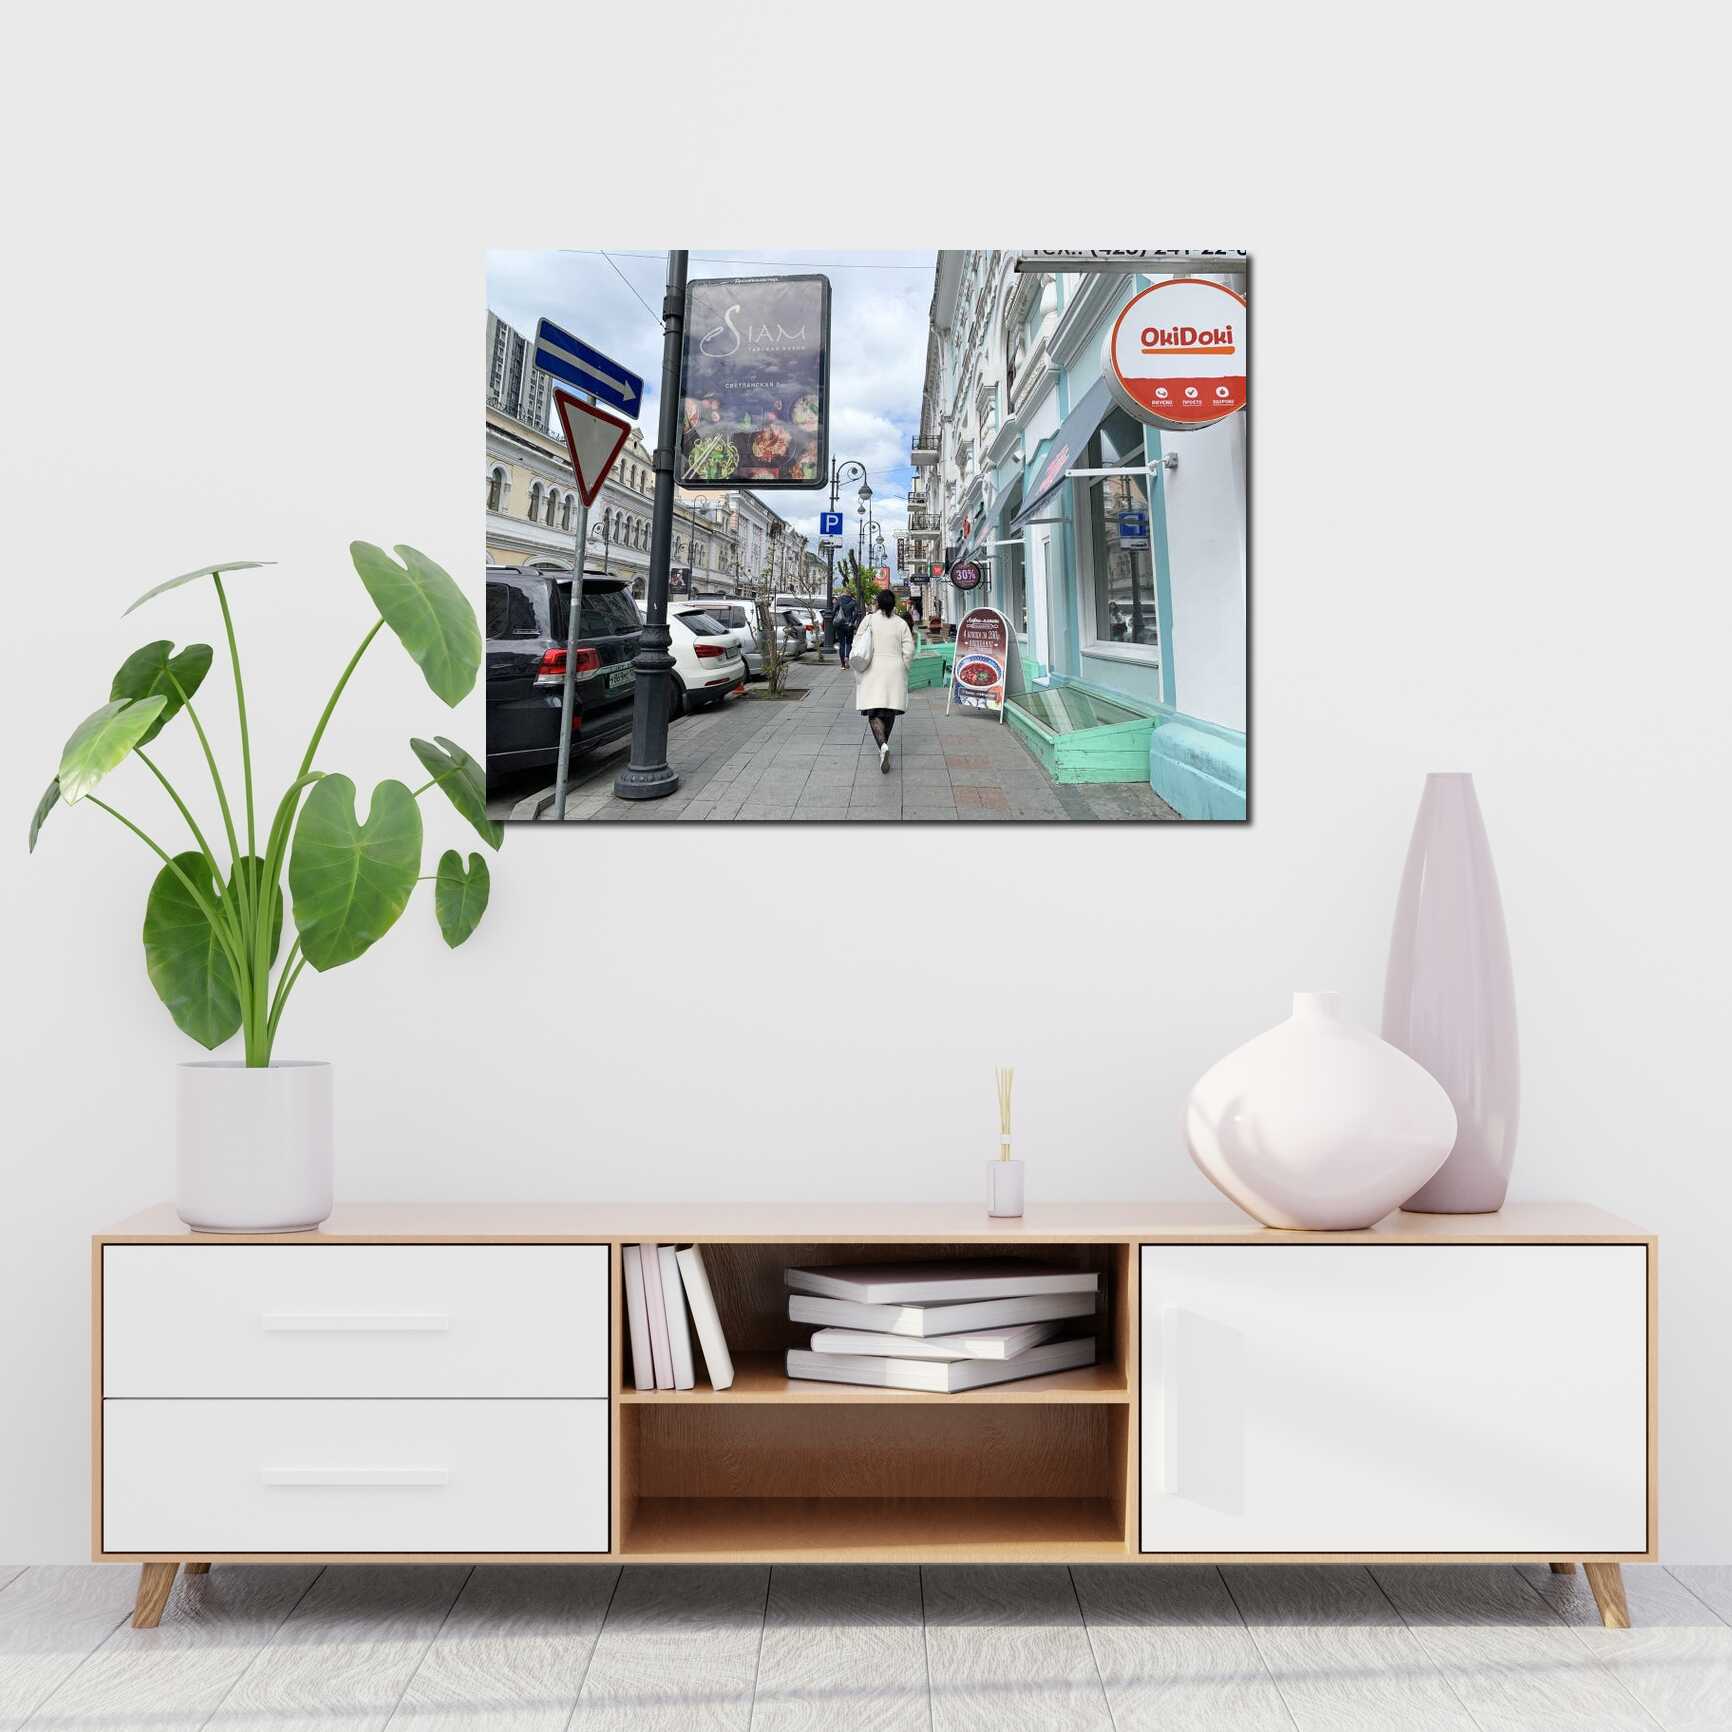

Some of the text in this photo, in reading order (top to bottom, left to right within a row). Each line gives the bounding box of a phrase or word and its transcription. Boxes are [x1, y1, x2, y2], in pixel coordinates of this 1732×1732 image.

[1141, 325, 1233, 347] OkiDoki
[826, 514, 839, 533] P
[955, 569, 976, 580] 30%
